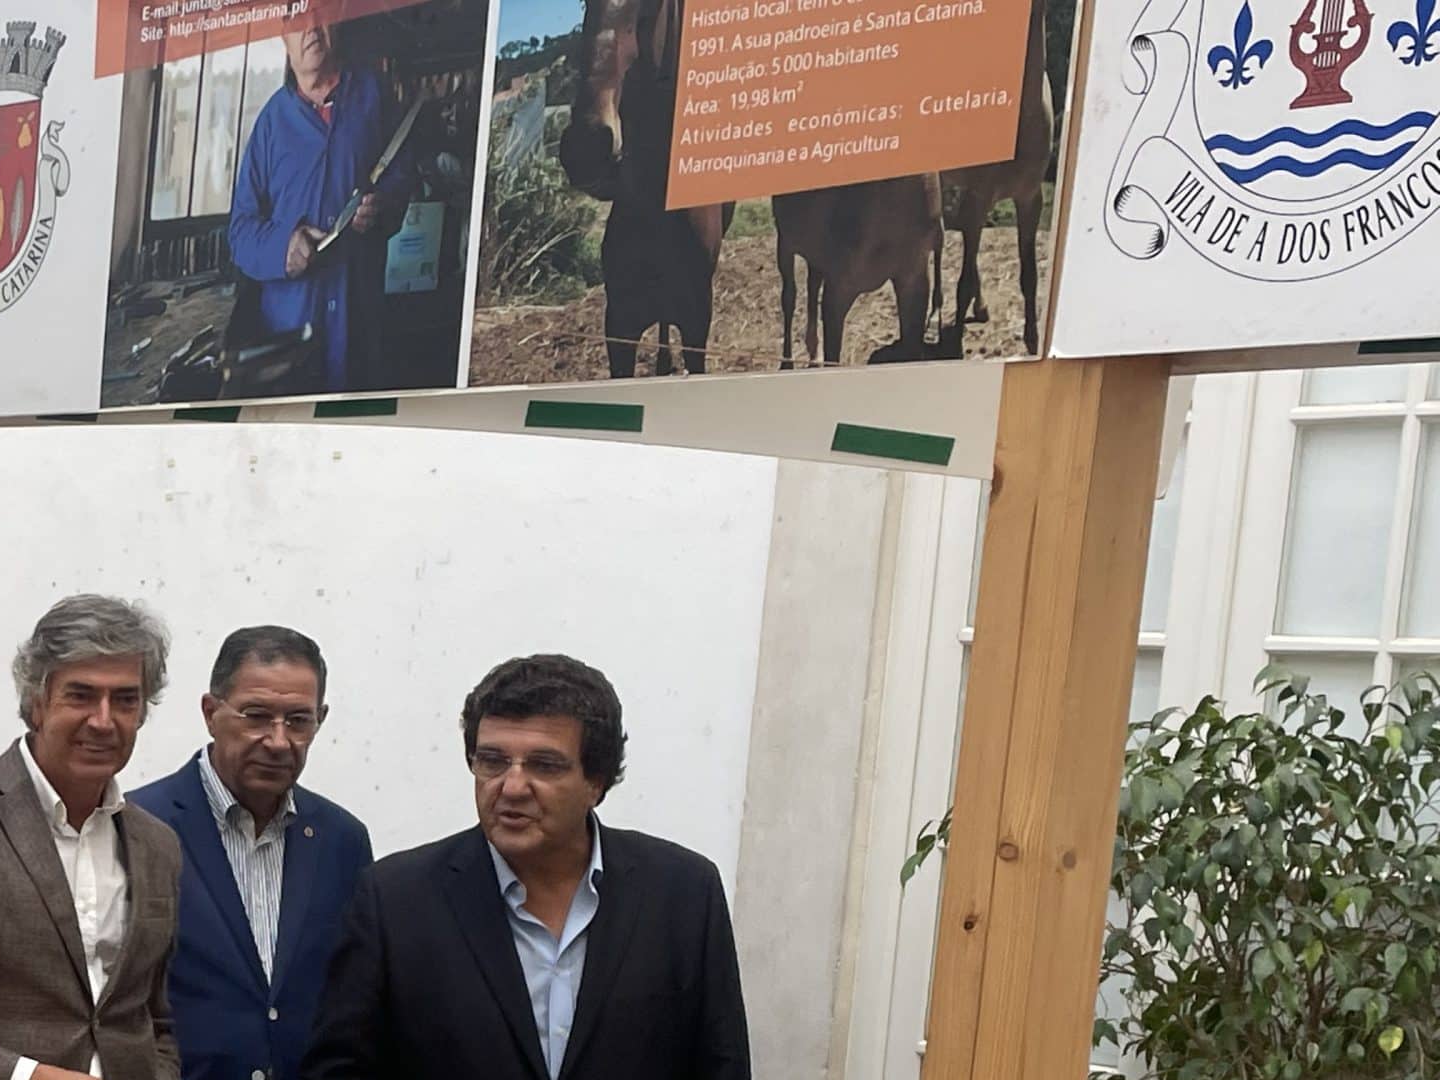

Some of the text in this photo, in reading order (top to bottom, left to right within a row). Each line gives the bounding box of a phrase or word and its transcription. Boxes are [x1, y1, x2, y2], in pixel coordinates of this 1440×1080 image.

[692, 7, 750, 28] História
[731, 34, 744, 51] A
[745, 33, 772, 49] sua
[775, 19, 850, 48] padroeira
[853, 15, 863, 33] é
[865, 11, 911, 31] Santa
[771, 57, 781, 75] 5
[783, 52, 812, 74] 000
[815, 43, 900, 68] habitantes
[680, 87, 1013, 146] Atividades económicas: Cutelaria,
[731, 88, 769, 111] 19,98
[678, 135, 900, 175] Marroquinaria e a Agricultura
[1165, 149, 1440, 265] VILA DE A DOS FRANCO
[1, 216, 53, 303] CATARINA
